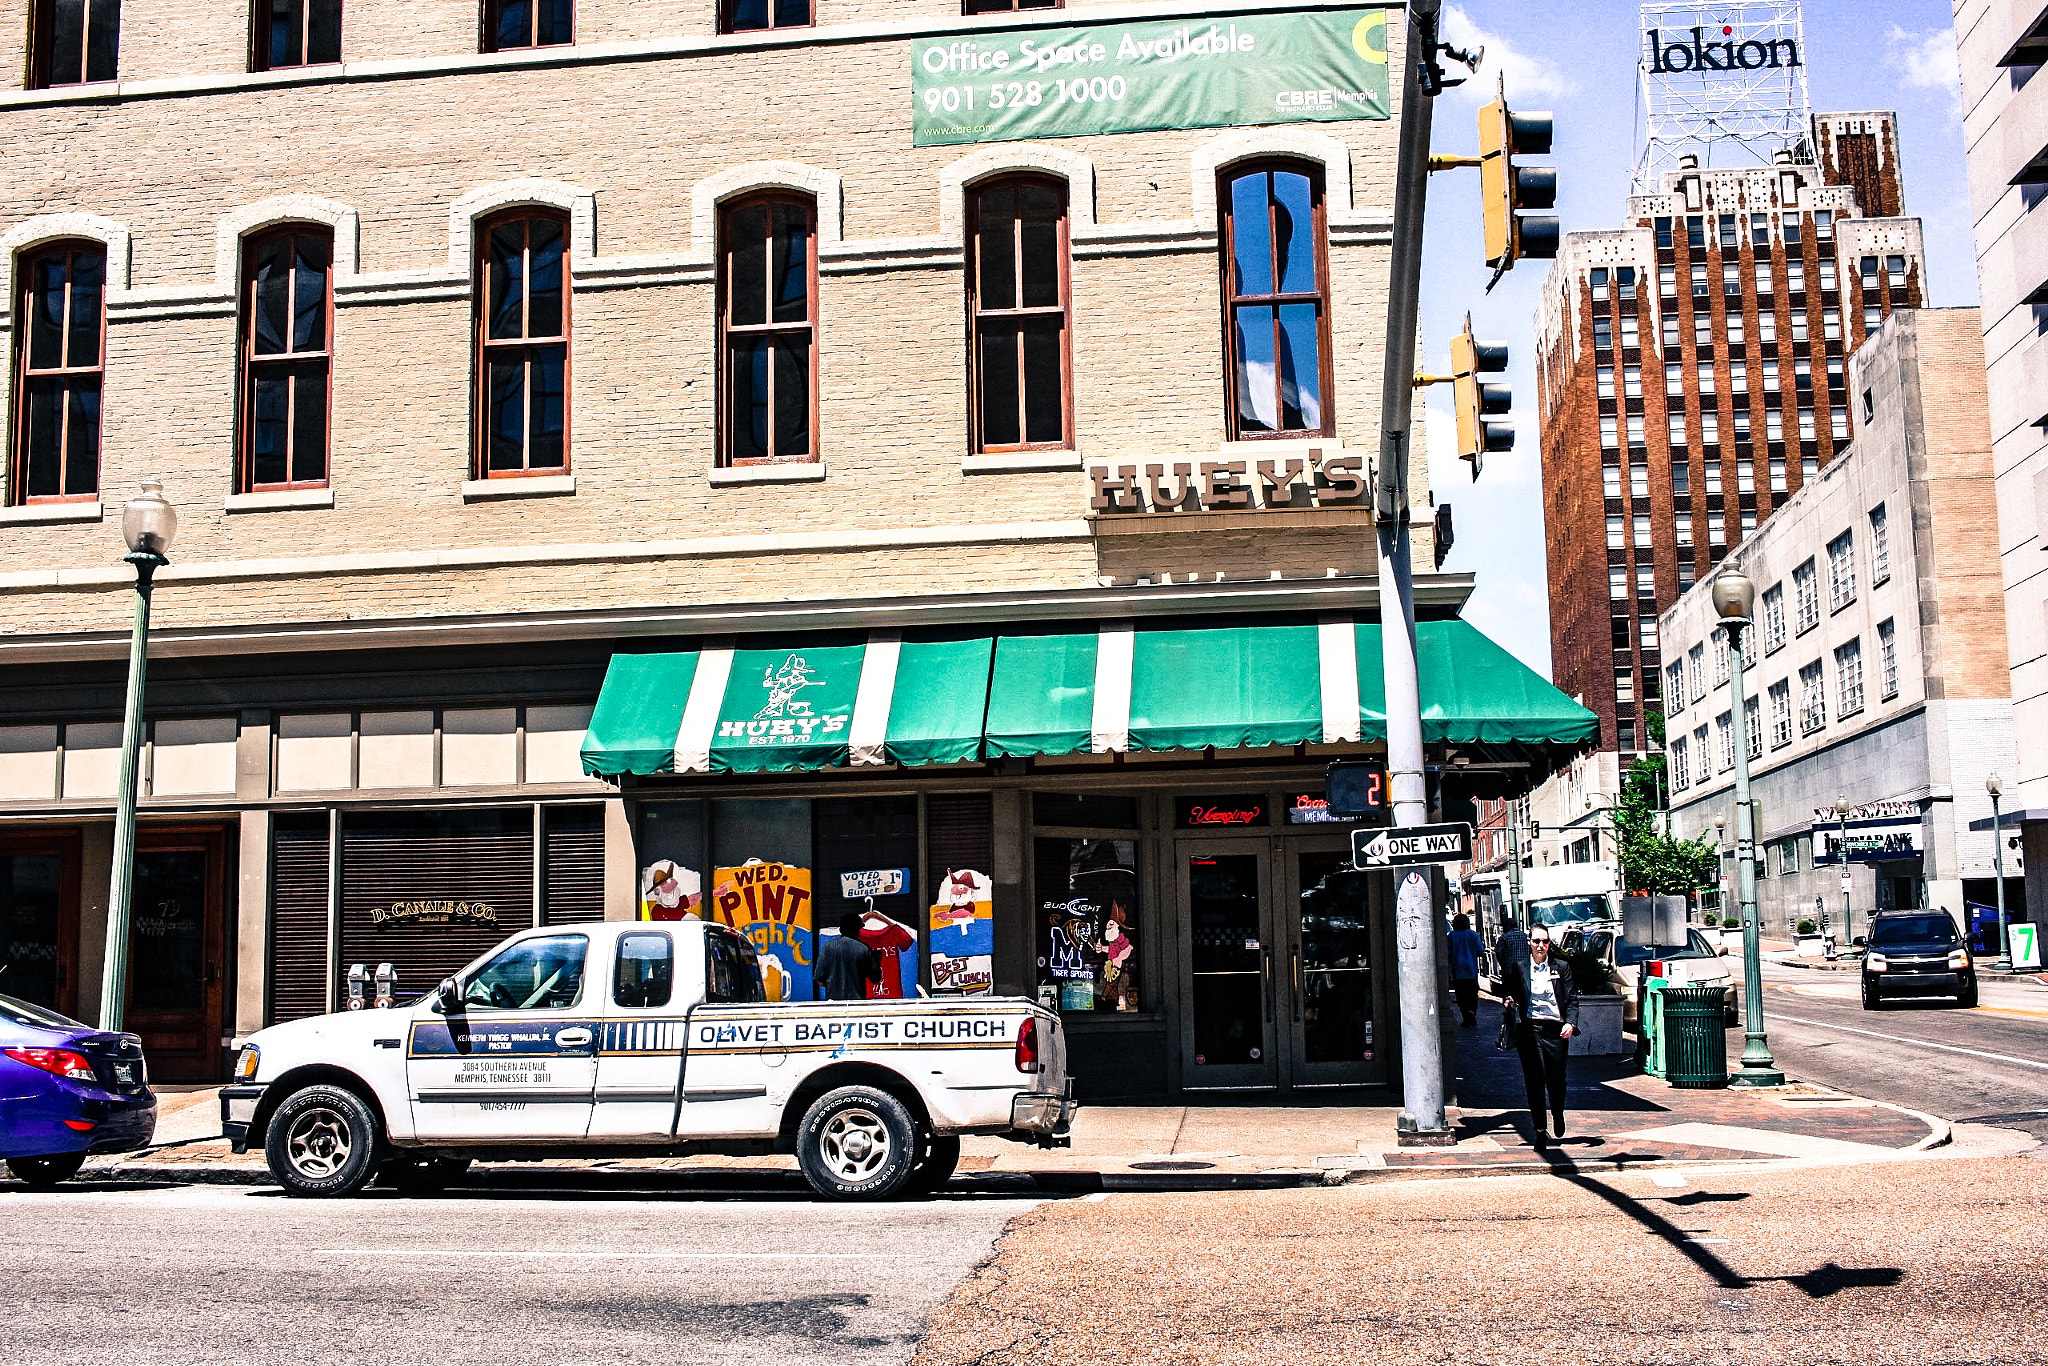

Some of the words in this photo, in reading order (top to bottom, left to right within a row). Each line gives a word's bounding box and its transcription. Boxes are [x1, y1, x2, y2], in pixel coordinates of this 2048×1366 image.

[922, 41, 1010, 74] Office
[1019, 39, 1106, 74] Space
[1115, 23, 1255, 60] Available
[1647, 26, 1802, 74] lokion
[923, 85, 974, 114] 901
[988, 80, 1043, 109] 528
[1056, 74, 1127, 104] 1000
[1275, 90, 1333, 106] CBRE
[1337, 87, 1378, 105] Memphis
[924, 124, 997, 136] www.cbre.com
[1090, 448, 1364, 509] HUEY'S
[718, 714, 849, 737] HUEY'S
[748, 735, 777, 745] EST.
[781, 734, 811, 744] 1970
[1367, 773, 1381, 806] 2
[1389, 839, 1421, 855] ONE
[1426, 834, 1460, 851] WAY
[734, 865, 788, 887] WED.
[843, 871, 880, 882] VOTED
[857, 878, 883, 889] Best
[847, 888, 880, 897] Burger
[370, 908, 390, 923] D.
[391, 900, 454, 917] CANALE
[456, 902, 469, 915] &
[471, 903, 497, 921] CO.
[719, 883, 811, 928] PINT
[1043, 901, 1067, 910] BUD
[1072, 902, 1102, 912] LIGHT
[744, 922, 797, 954] ight
[932, 957, 969, 980] BEST
[950, 972, 991, 986] LUNCH
[1051, 969, 1069, 977] TIGER
[1070, 969, 1094, 979] SPORTS
[700, 1024, 784, 1043] OLIVET
[795, 1021, 894, 1041] BAPTIST
[904, 1020, 1005, 1038] CHURCH
[488, 1042, 513, 1050] PASTOR
[480, 1061, 518, 1072] SOUTHERN
[519, 1061, 547, 1072] AVENUE
[454, 1073, 489, 1083] MEMPHIS,
[490, 1073, 528, 1083] TENNESSEE
[533, 1073, 551, 1083] 38111
